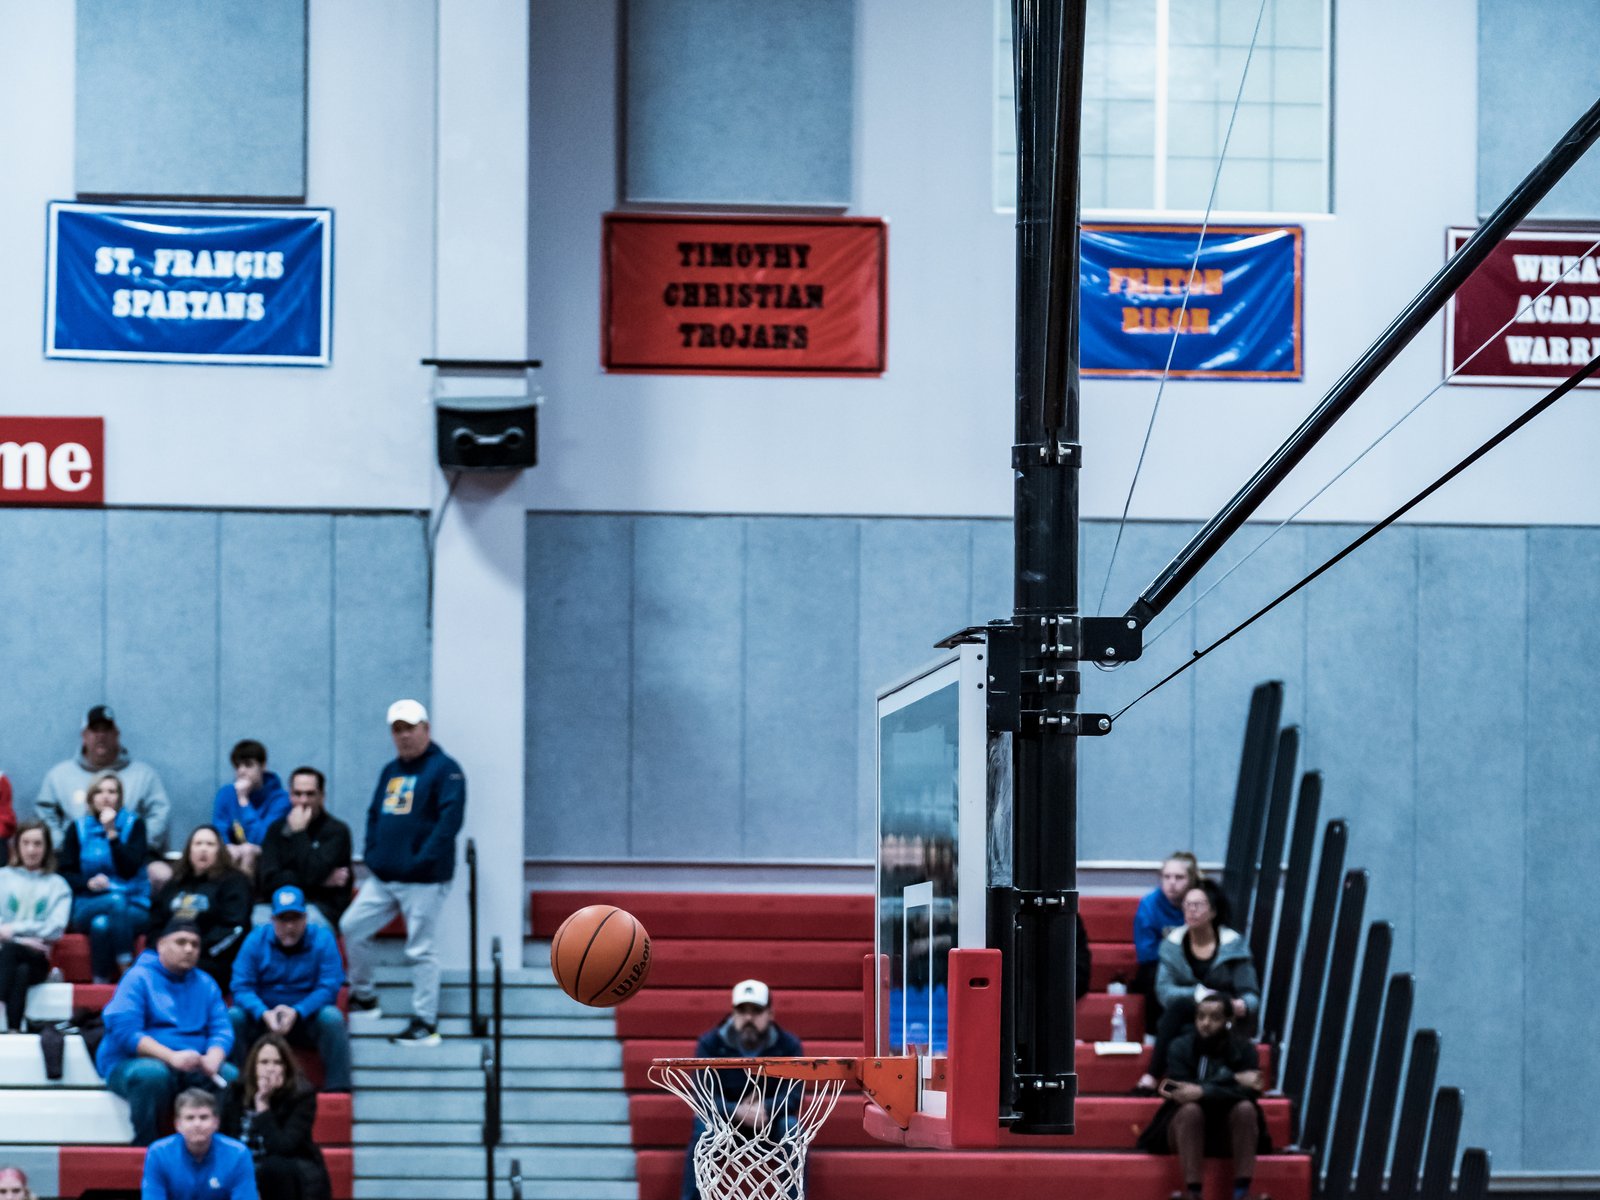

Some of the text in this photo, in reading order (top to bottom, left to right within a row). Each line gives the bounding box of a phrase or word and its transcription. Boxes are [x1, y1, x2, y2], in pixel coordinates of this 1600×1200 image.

[95, 247, 284, 279] ST. FRANCIS
[677, 242, 812, 269] TIMOTHY
[1512, 253, 1600, 284] WHEA
[664, 282, 824, 309] CHRISTIAN
[1109, 267, 1224, 296] FENTON
[112, 289, 265, 321] SPARTANS
[1122, 307, 1210, 334] BISON
[678, 322, 808, 349] TROJANS
[611, 936, 650, 996] Wilson
